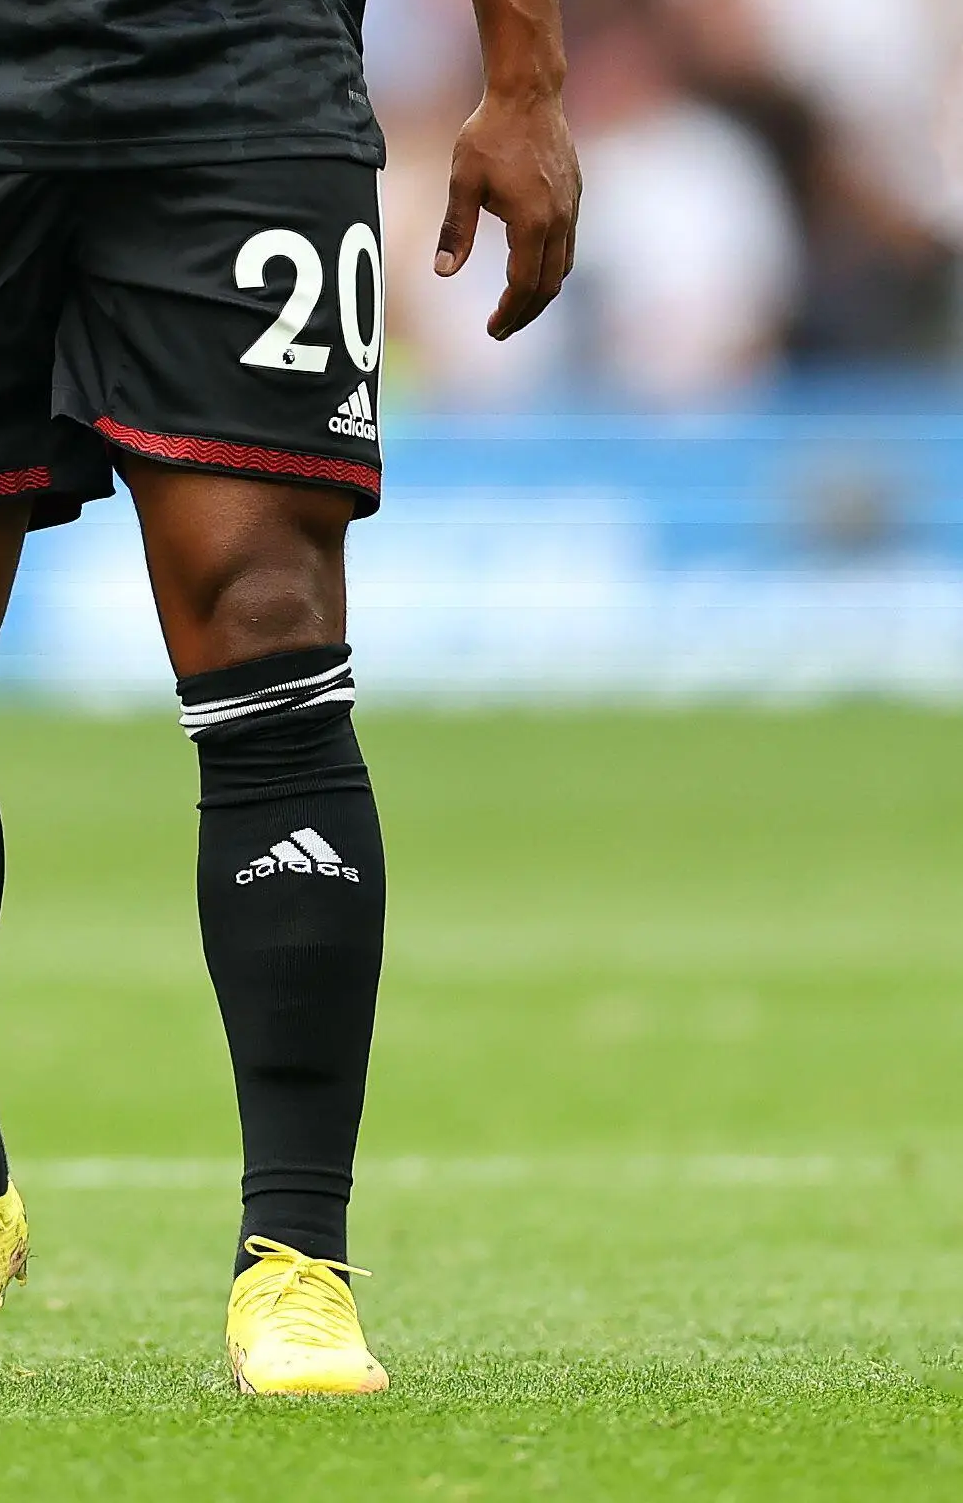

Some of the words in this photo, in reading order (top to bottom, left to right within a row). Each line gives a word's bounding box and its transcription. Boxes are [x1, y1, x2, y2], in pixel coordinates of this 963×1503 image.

[234, 222, 381, 373] 20
[328, 413, 376, 441] adidas
[235, 858, 359, 885] adidas
